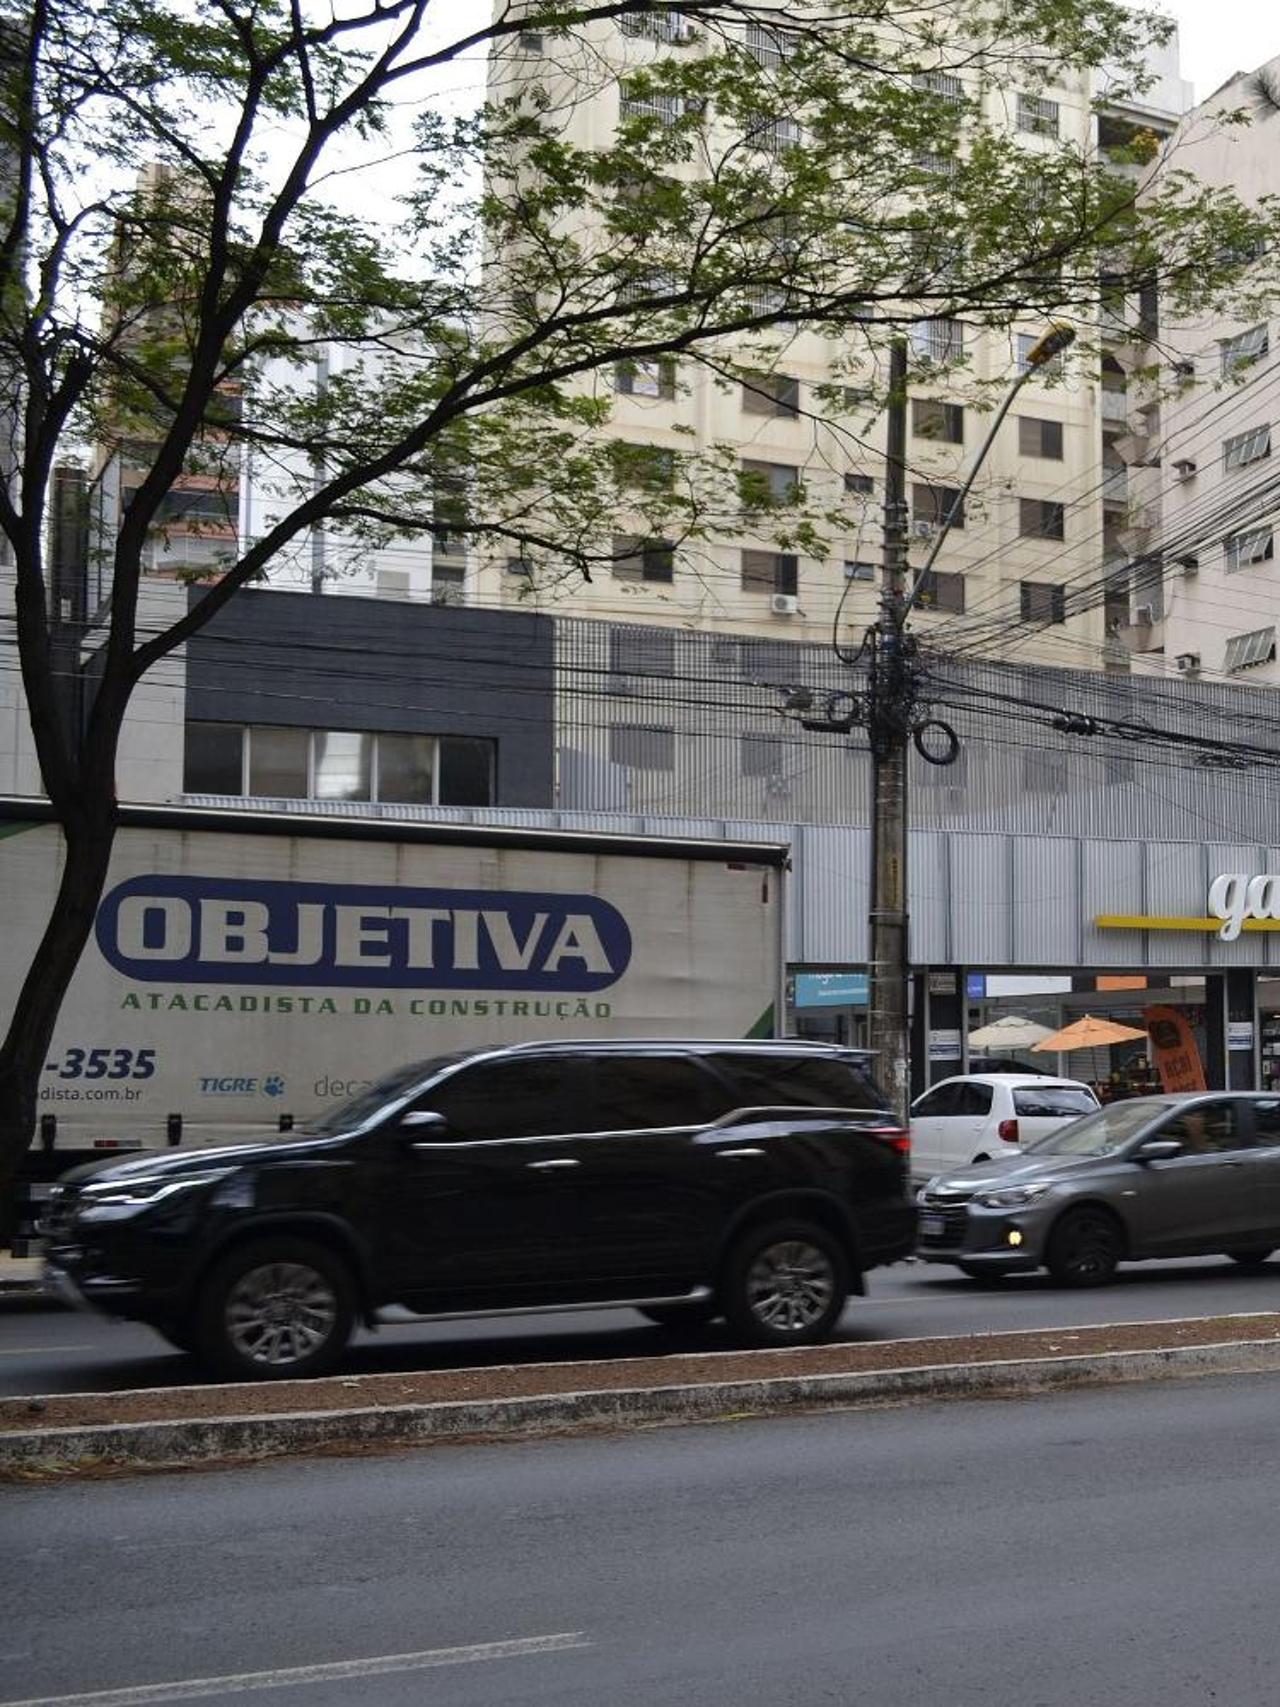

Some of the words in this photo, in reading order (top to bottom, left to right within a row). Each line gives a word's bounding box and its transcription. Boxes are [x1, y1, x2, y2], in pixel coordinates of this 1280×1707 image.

[116, 895, 615, 974] OBJETIVA
[121, 993, 338, 1014] ATACADISTA
[354, 998, 394, 1015] DA
[409, 997, 611, 1021] CONSTRUÇÃO
[200, 1077, 258, 1093] TIGRE
